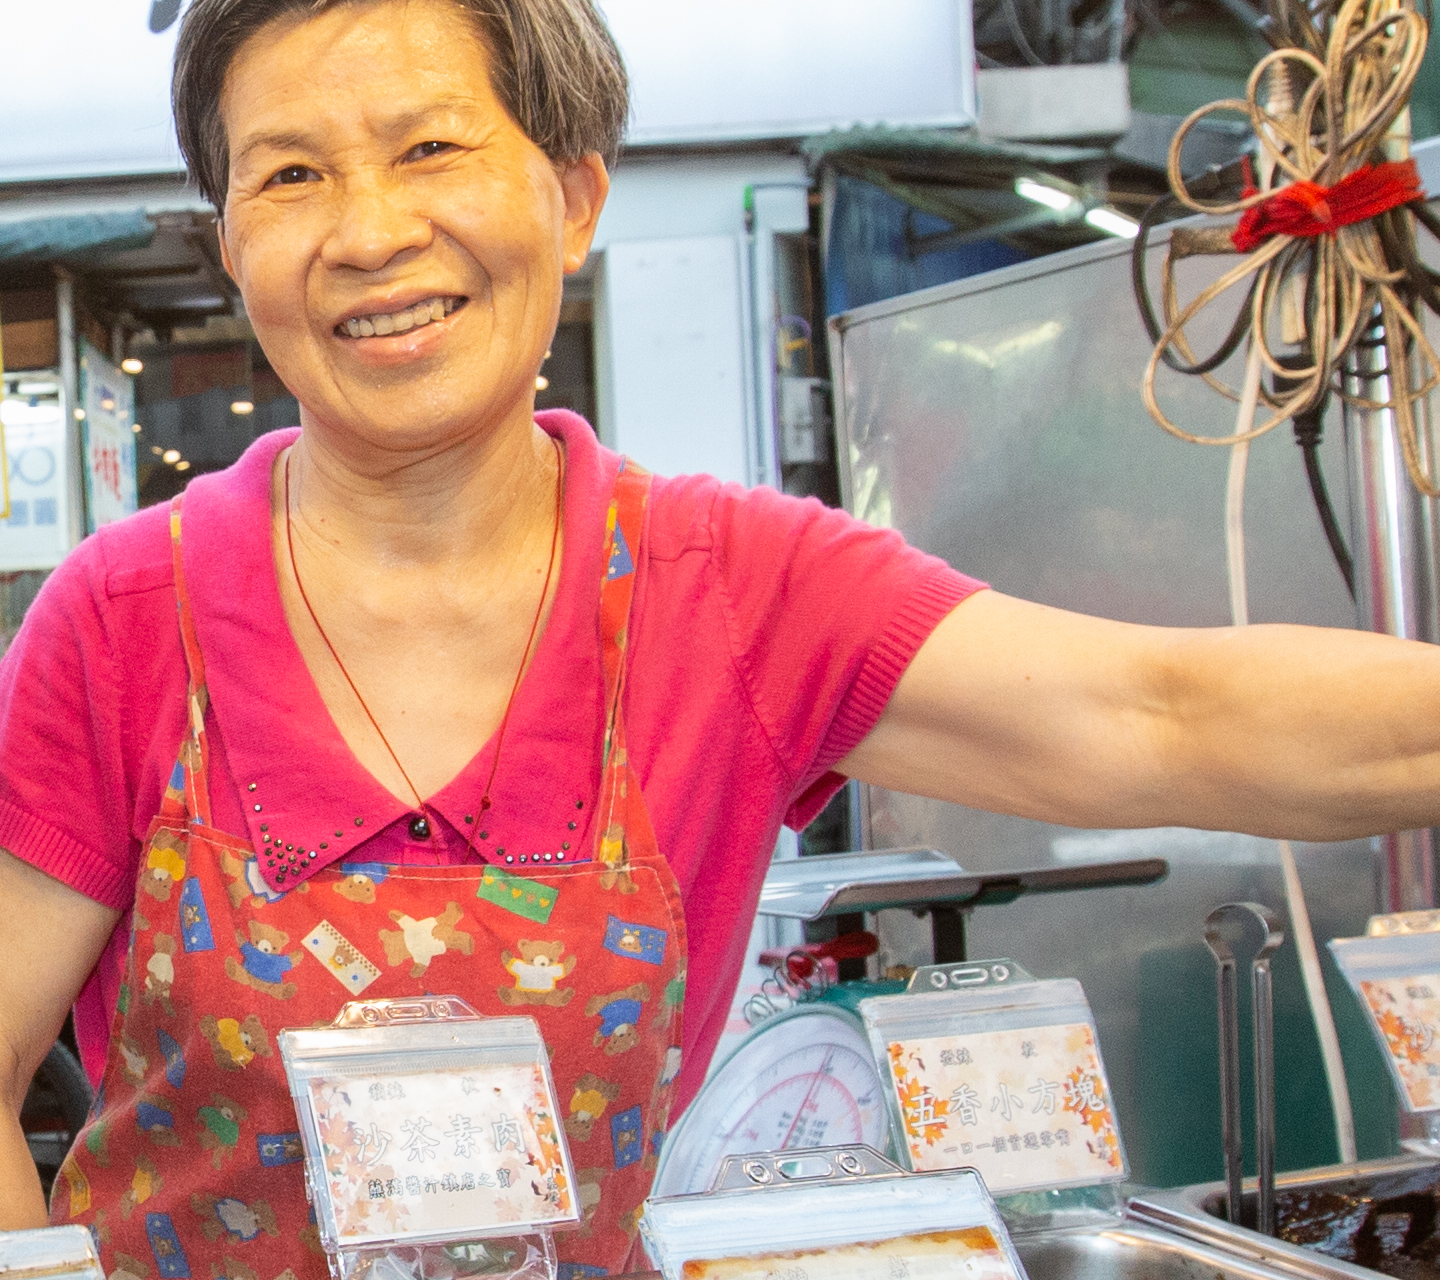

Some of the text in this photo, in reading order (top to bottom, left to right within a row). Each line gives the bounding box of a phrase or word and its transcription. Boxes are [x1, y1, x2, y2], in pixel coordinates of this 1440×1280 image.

[910, 1073, 1106, 1129] 五香小方塊
[351, 1111, 528, 1168] 沙茶素肉
